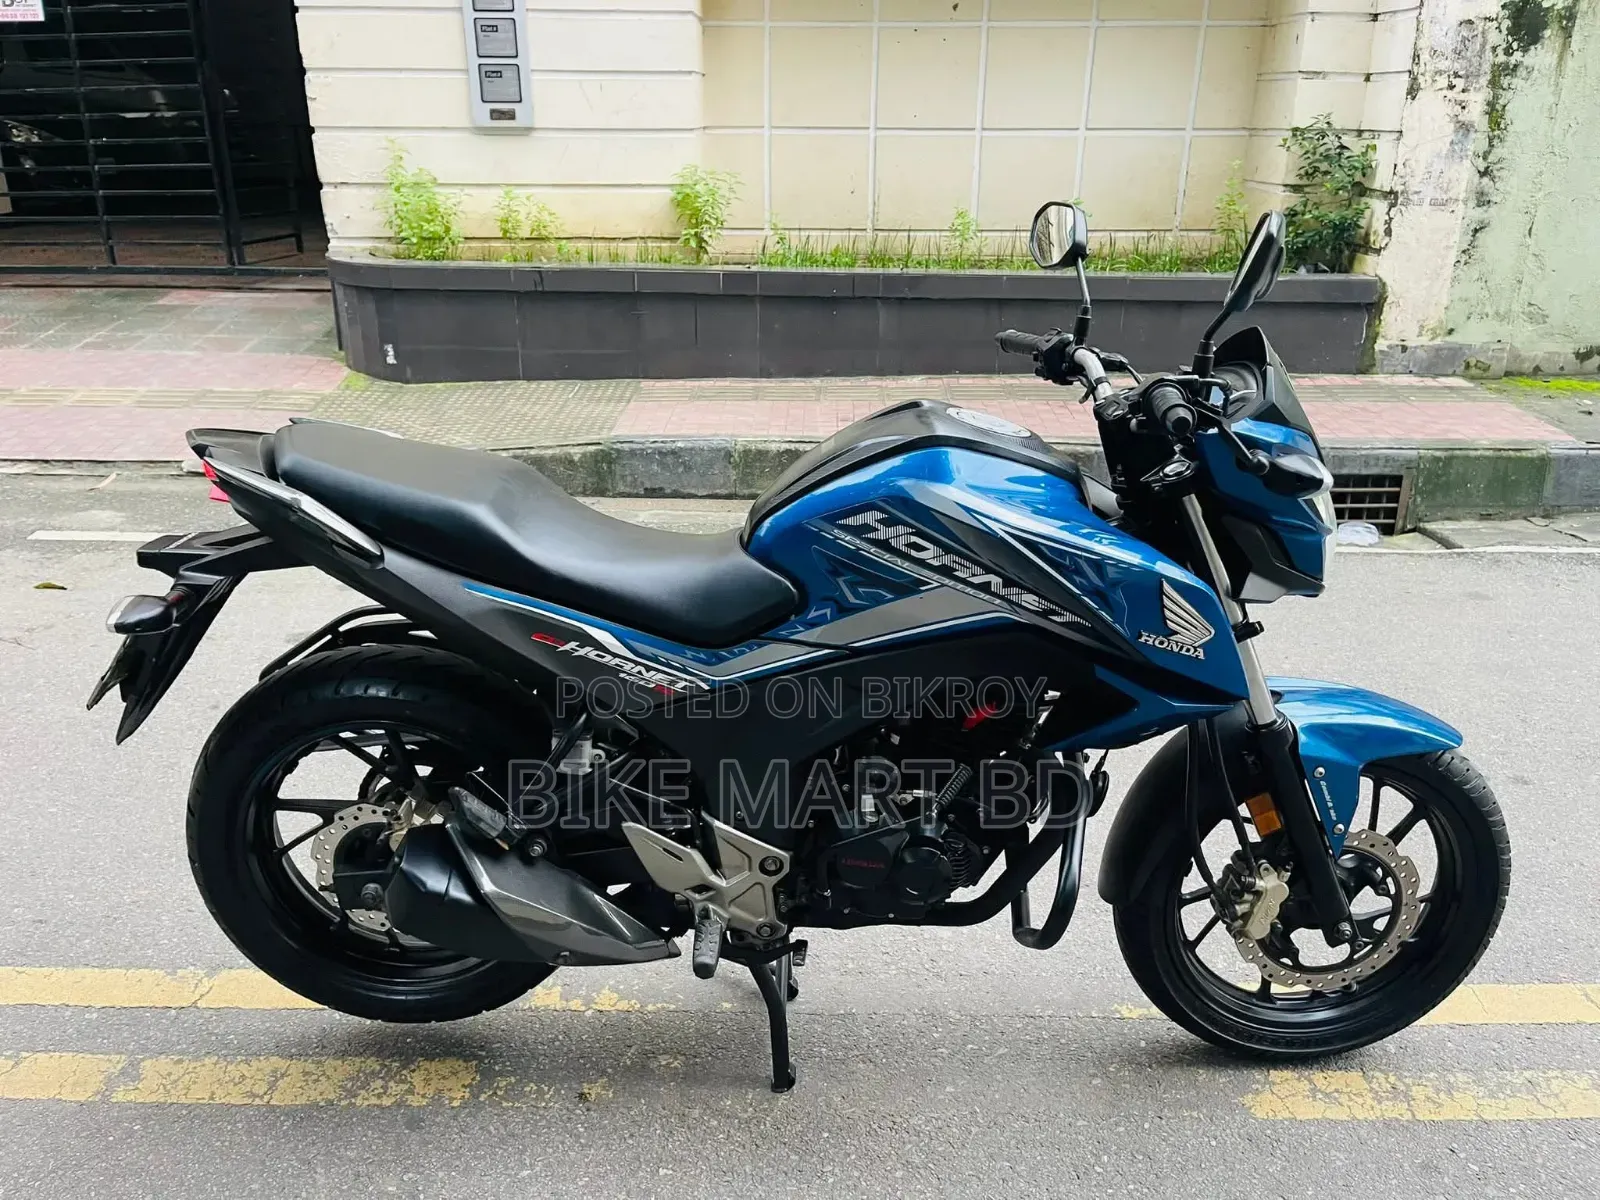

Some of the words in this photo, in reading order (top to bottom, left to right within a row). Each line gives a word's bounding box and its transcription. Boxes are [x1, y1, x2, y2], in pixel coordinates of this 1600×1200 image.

[833, 530, 912, 571] SPECIAL
[916, 566, 1002, 605] EDITION
[555, 640, 696, 692] HORNET
[1138, 629, 1206, 660] HONDA
